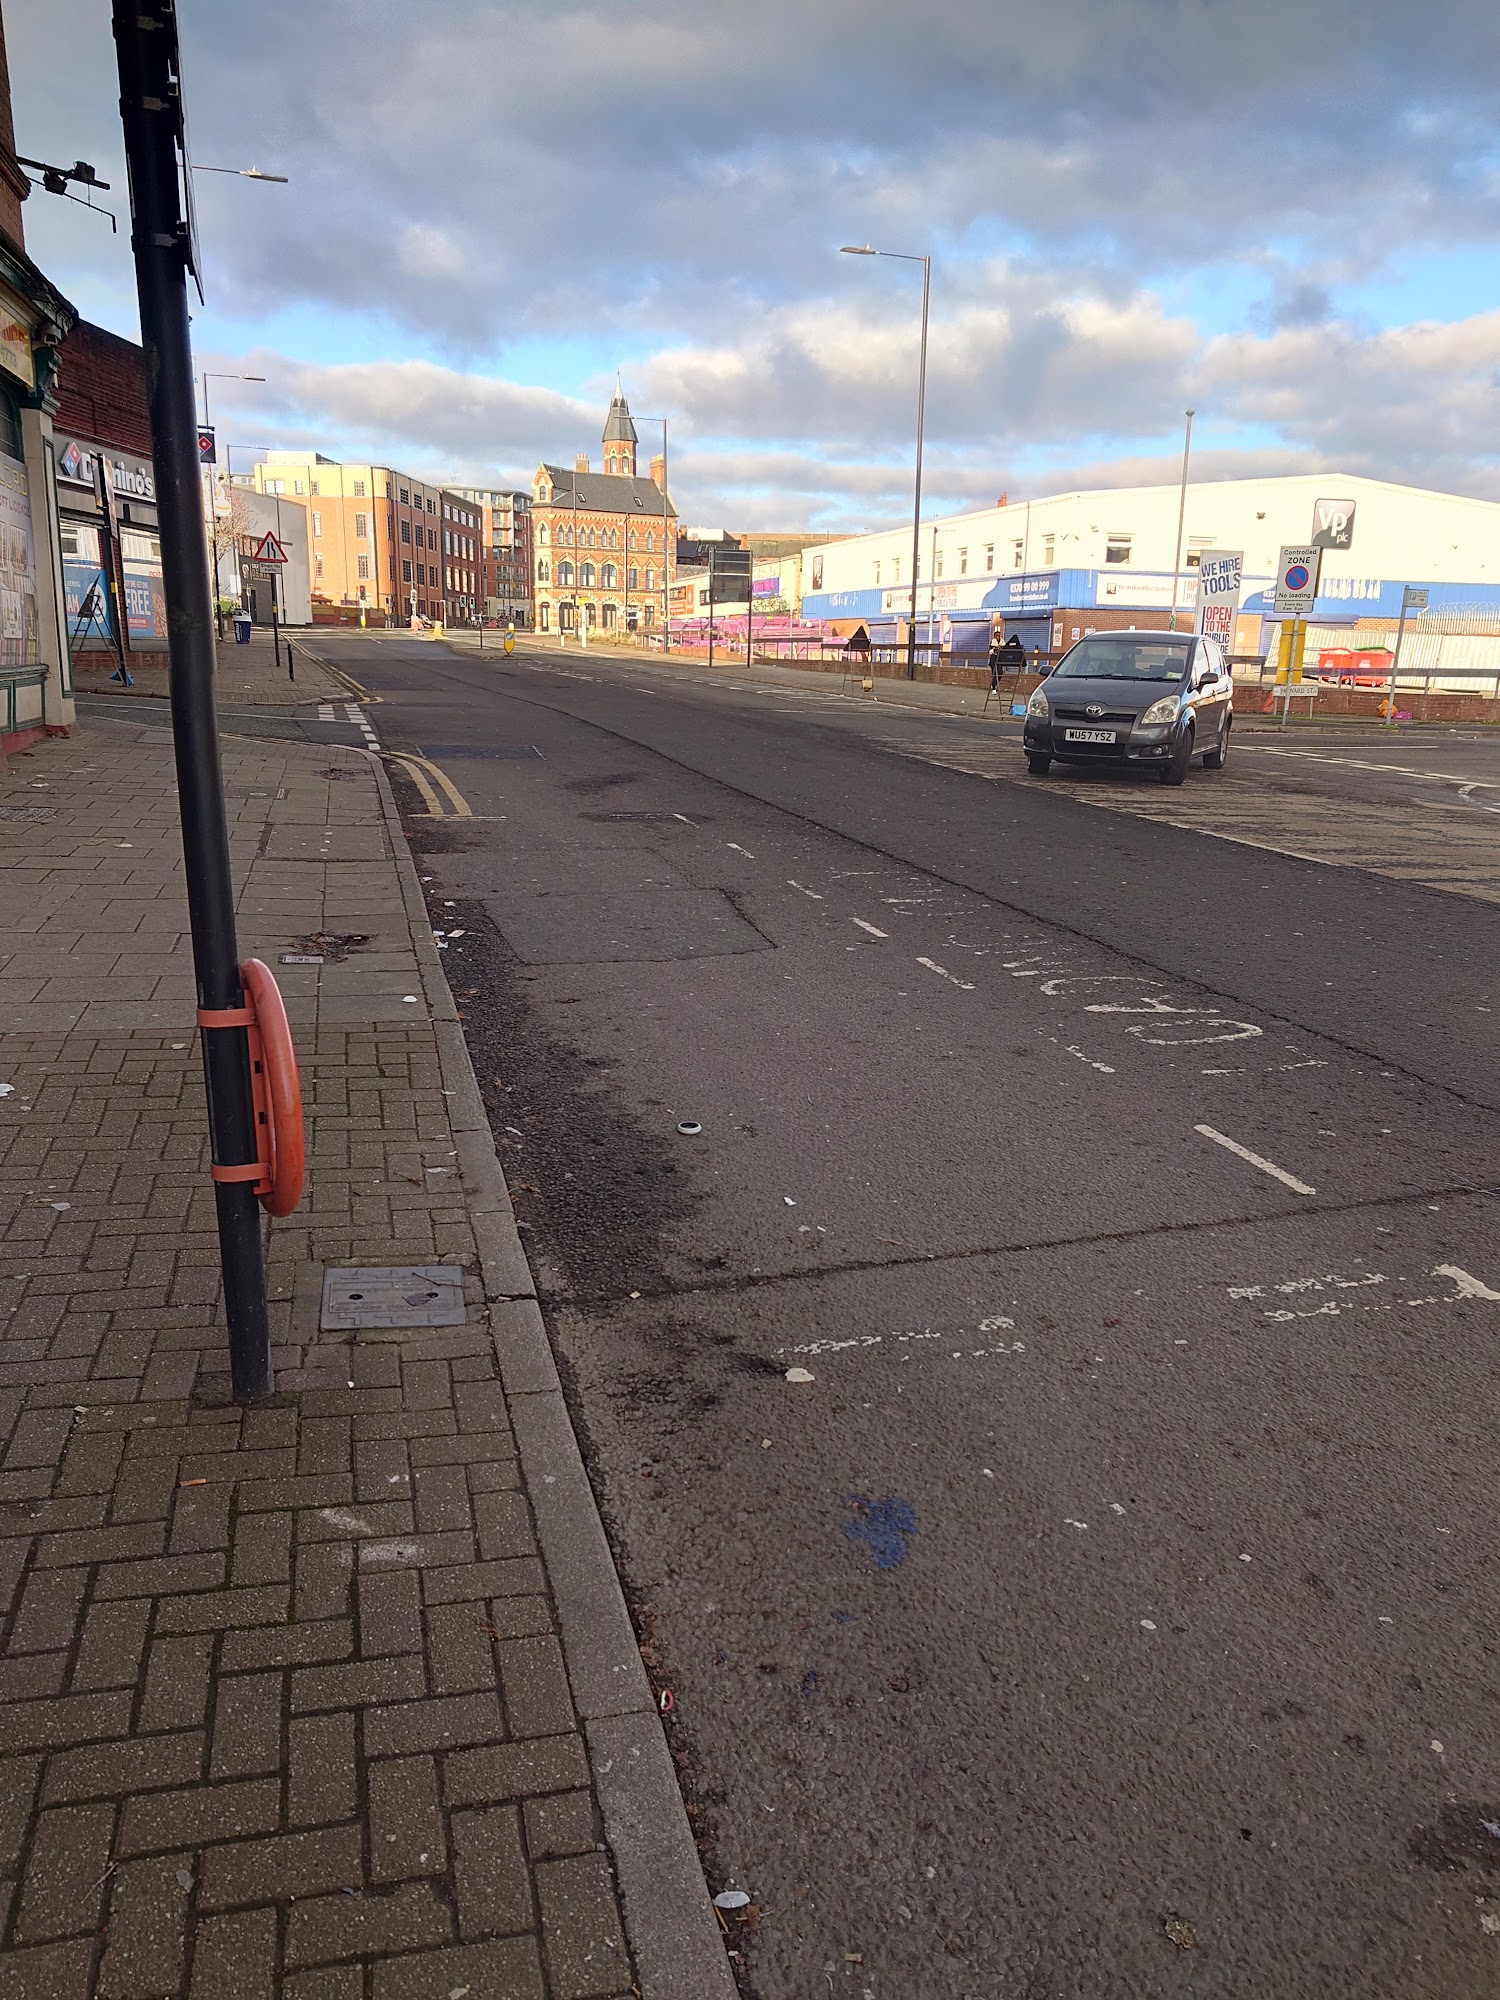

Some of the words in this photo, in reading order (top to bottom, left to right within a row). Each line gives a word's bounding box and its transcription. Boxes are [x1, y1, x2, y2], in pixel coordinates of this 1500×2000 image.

[80, 451, 154, 497] Dmino's
[1318, 507, 1348, 537] Vp
[1336, 531, 1349, 544] plc
[1201, 562, 1217, 578] WE
[1218, 557, 1241, 574] HIRE
[1010, 583, 1022, 593] 0370
[1023, 582, 1030, 592] 99
[1031, 582, 1038, 591] 00
[1039, 581, 1050, 591] 999
[1201, 572, 1241, 596] TOOLS
[125, 588, 151, 616] FREE
[1206, 606, 1232, 620] OPEN
[1205, 620, 1215, 632] TO
[1216, 620, 1231, 632] THE
[1069, 730, 1092, 740] WU57
[1095, 731, 1112, 741] YSZ
